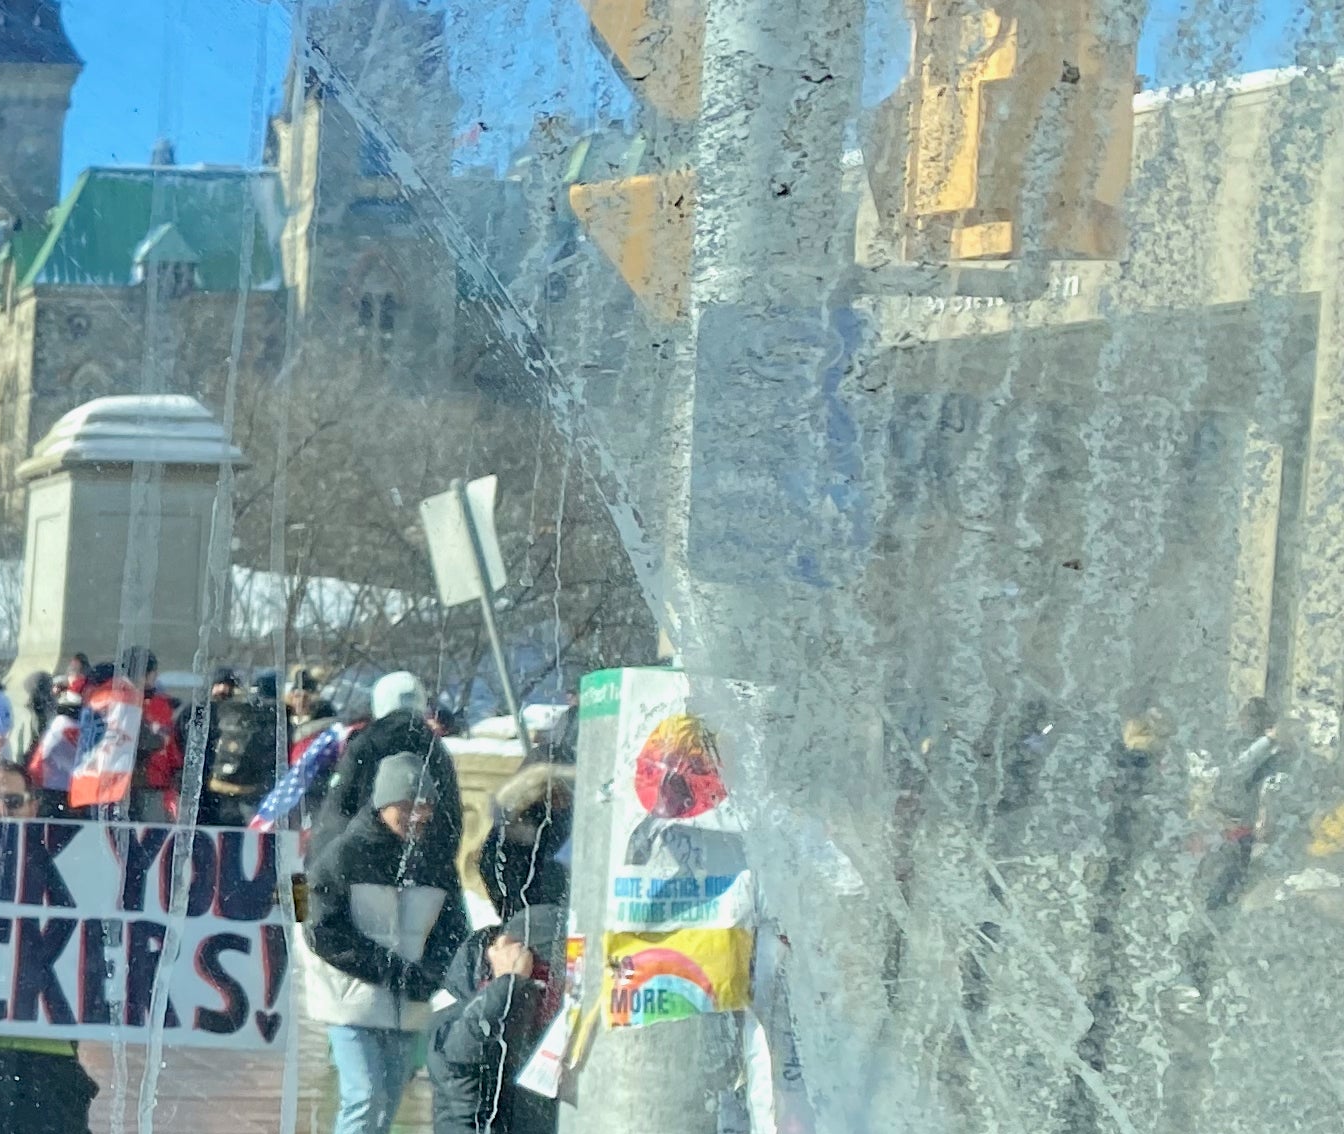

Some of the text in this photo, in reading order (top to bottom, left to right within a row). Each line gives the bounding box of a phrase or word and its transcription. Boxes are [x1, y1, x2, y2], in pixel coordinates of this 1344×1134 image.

[108, 827, 278, 922] YOU
[628, 900, 666, 923] MORE
[610, 988, 670, 1015] MORE
